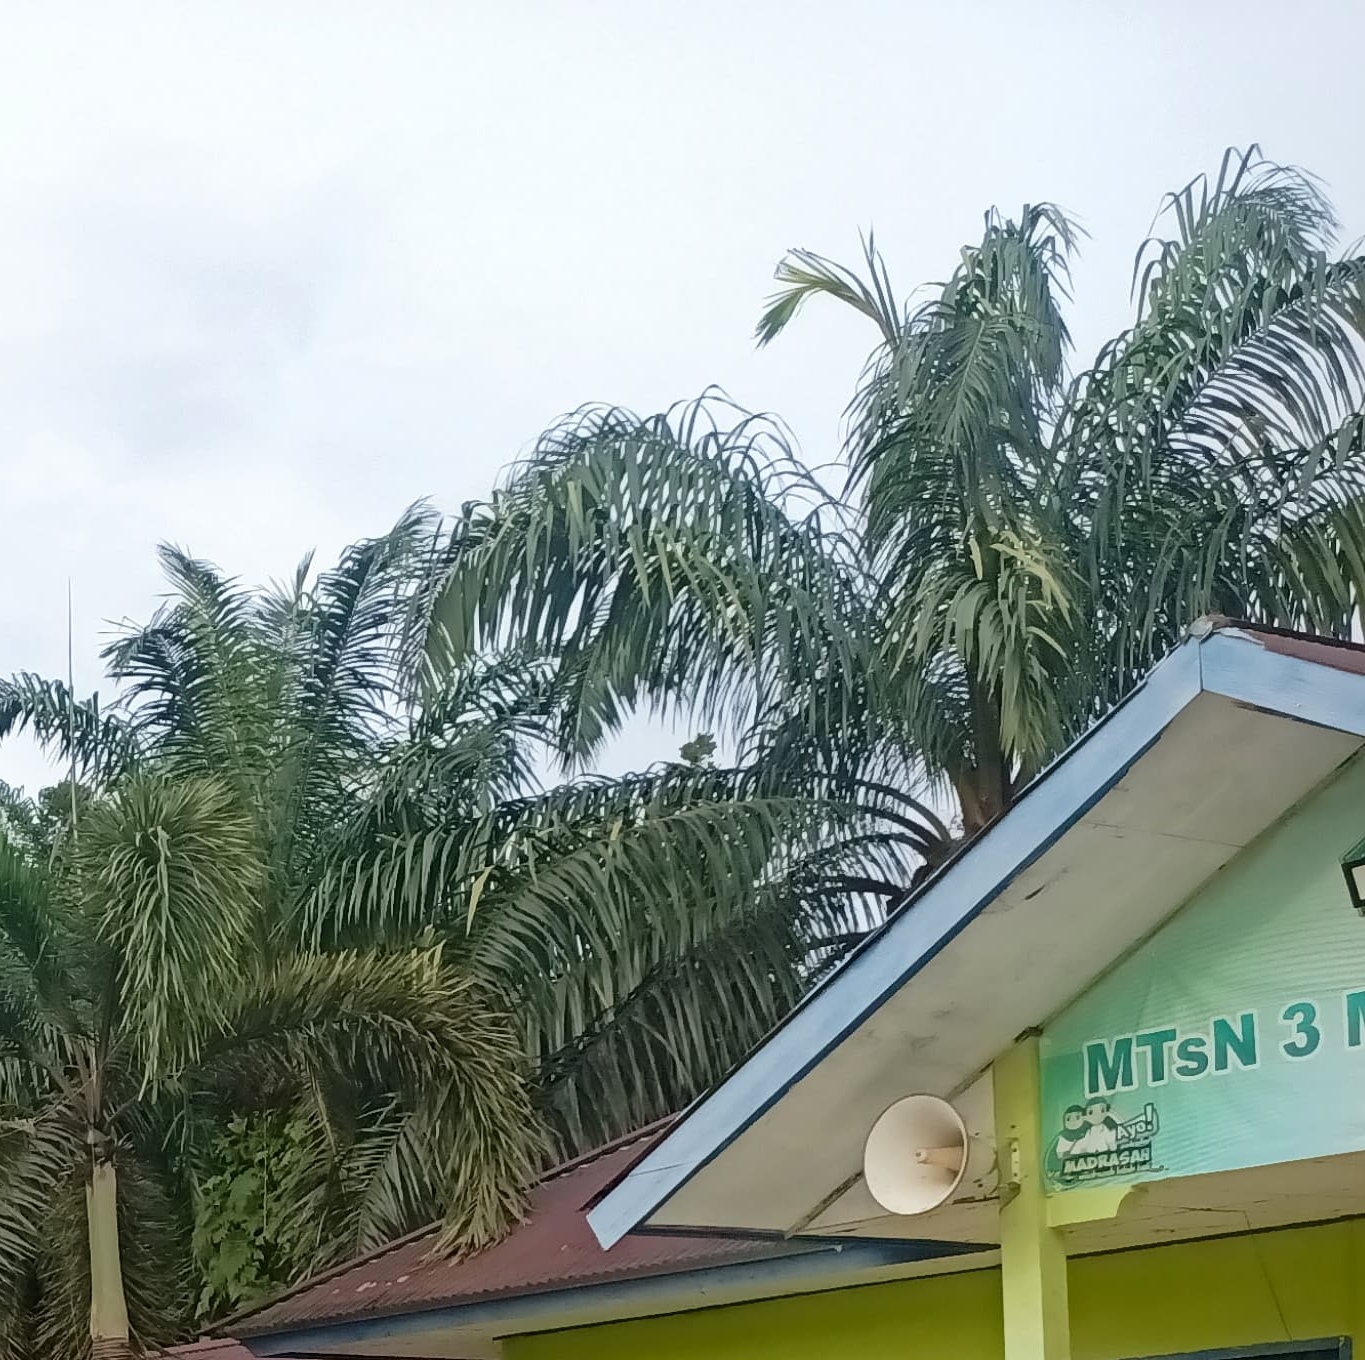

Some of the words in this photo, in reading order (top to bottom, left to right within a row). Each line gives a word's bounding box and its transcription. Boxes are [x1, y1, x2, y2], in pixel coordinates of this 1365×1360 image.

[1086, 1013, 1257, 1094] MTsN
[1282, 1002, 1320, 1058] 3
[1116, 1103, 1154, 1139] Ayo!
[1064, 1146, 1150, 1174] MADRASAH
